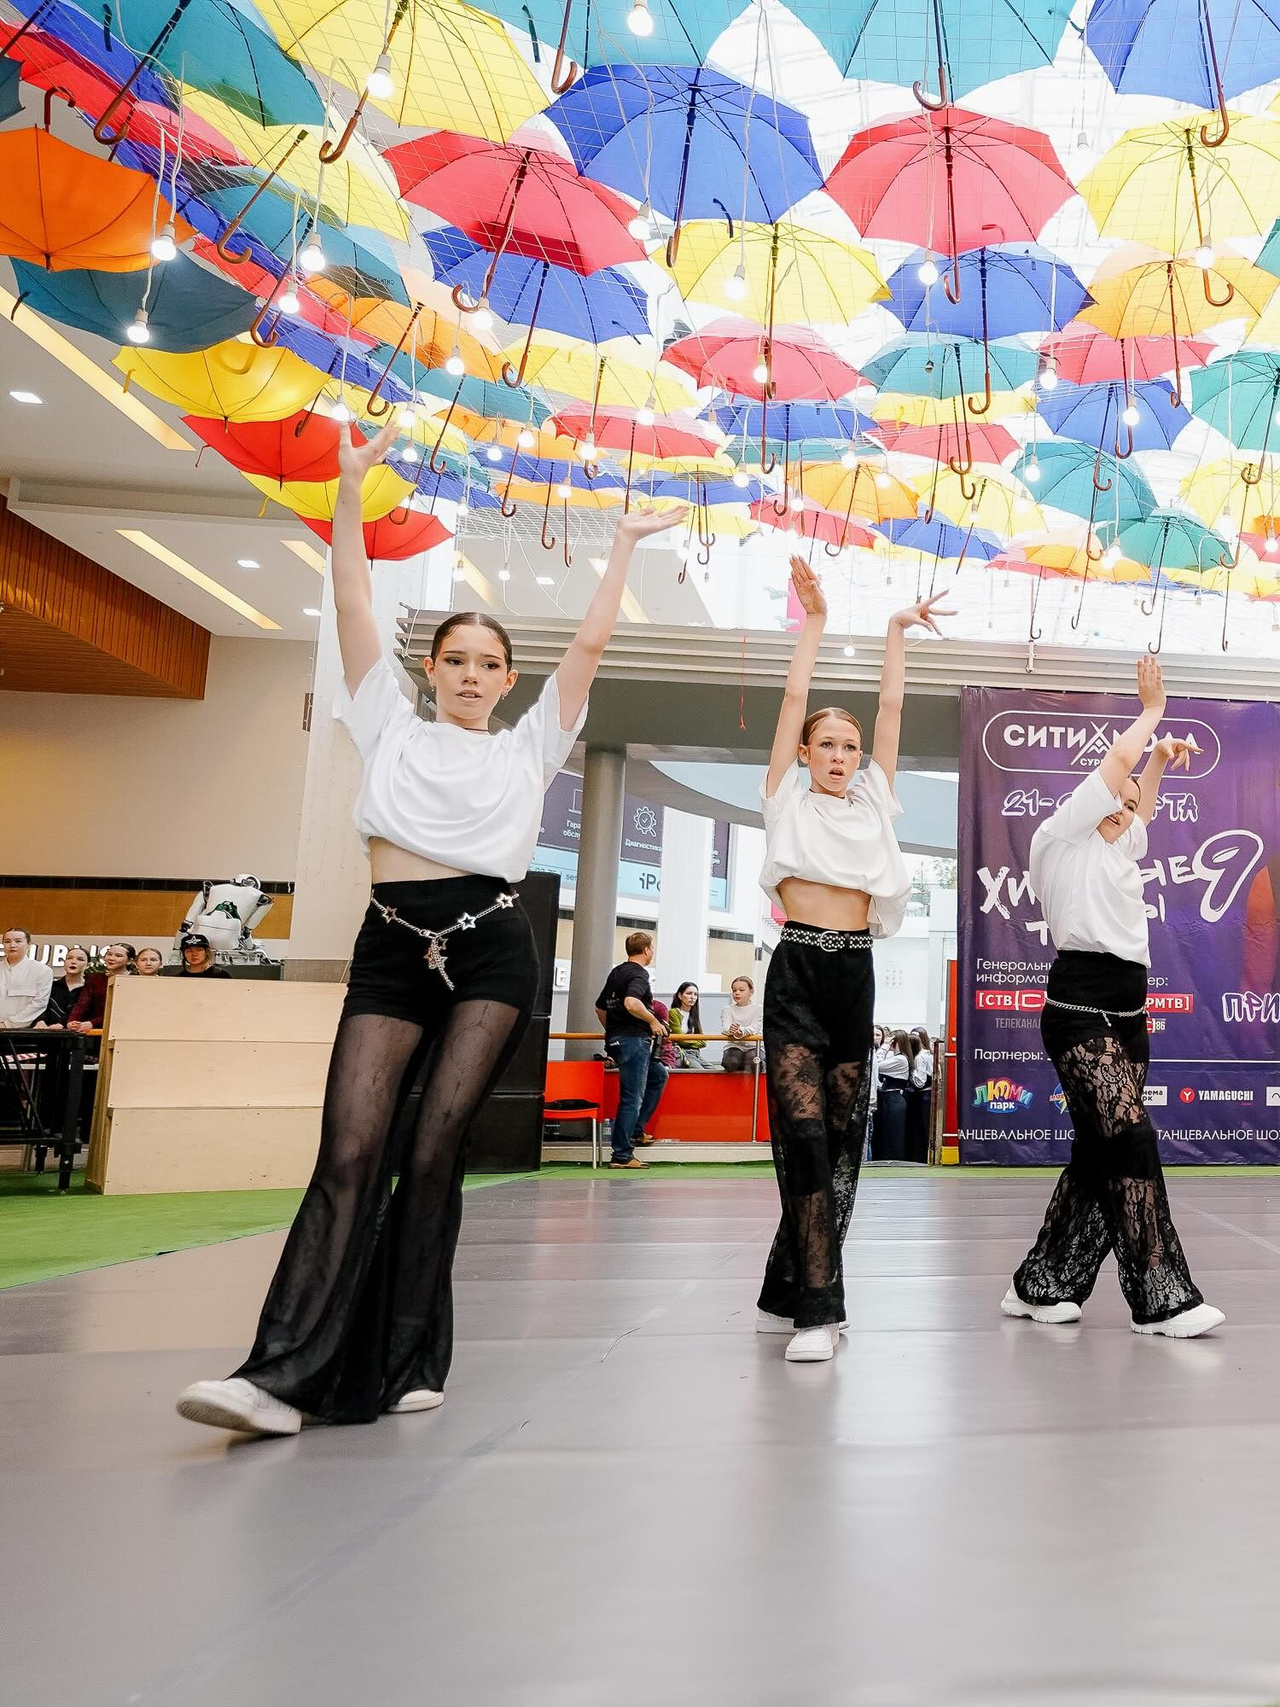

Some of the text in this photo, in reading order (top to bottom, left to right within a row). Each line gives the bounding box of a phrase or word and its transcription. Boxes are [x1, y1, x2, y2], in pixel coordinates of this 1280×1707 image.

[976, 958, 1052, 972] Генеральн
[974, 1049, 1043, 1062] Партнеры:
[1198, 1090, 1254, 1101] YAMAGUCHI
[990, 1101, 1015, 1111] парк
[1157, 1129, 1253, 1141] ТАНЦЕВАЛЬНОЕ
